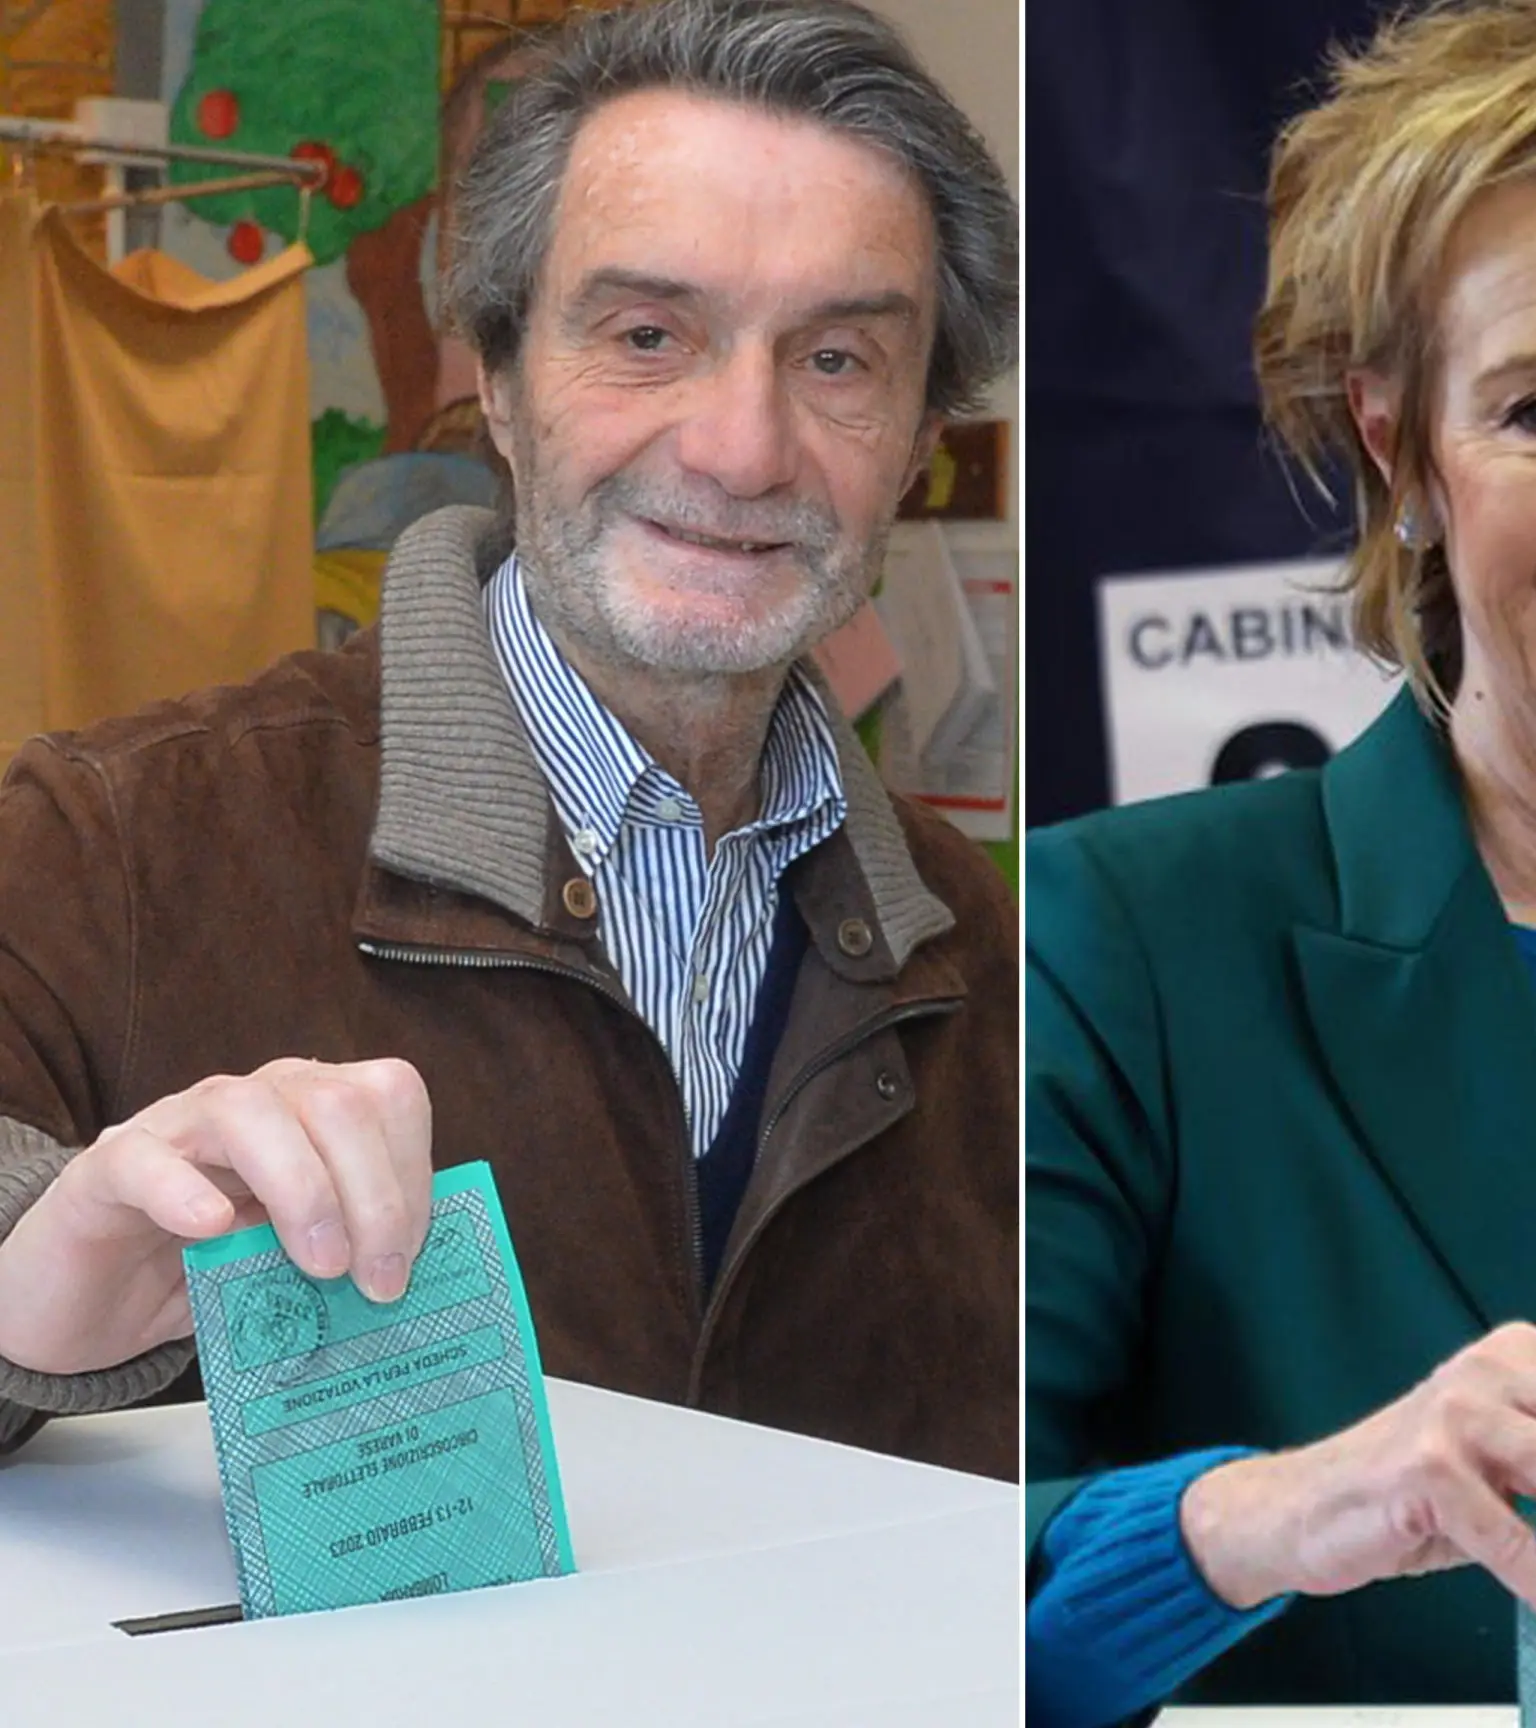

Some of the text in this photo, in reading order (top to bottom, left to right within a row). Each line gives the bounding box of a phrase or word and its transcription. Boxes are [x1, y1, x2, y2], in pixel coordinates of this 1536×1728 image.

[1127, 604, 1348, 669] CABIN
[282, 1345, 468, 1413] SCHEDA PER LA VOTAZIONE
[302, 1429, 478, 1499] CIRCOSCRIZIONE ELETTORALE
[356, 1426, 420, 1459] DI VARESE
[330, 1497, 474, 1558] 12-13 FEBBRAIO 2023
